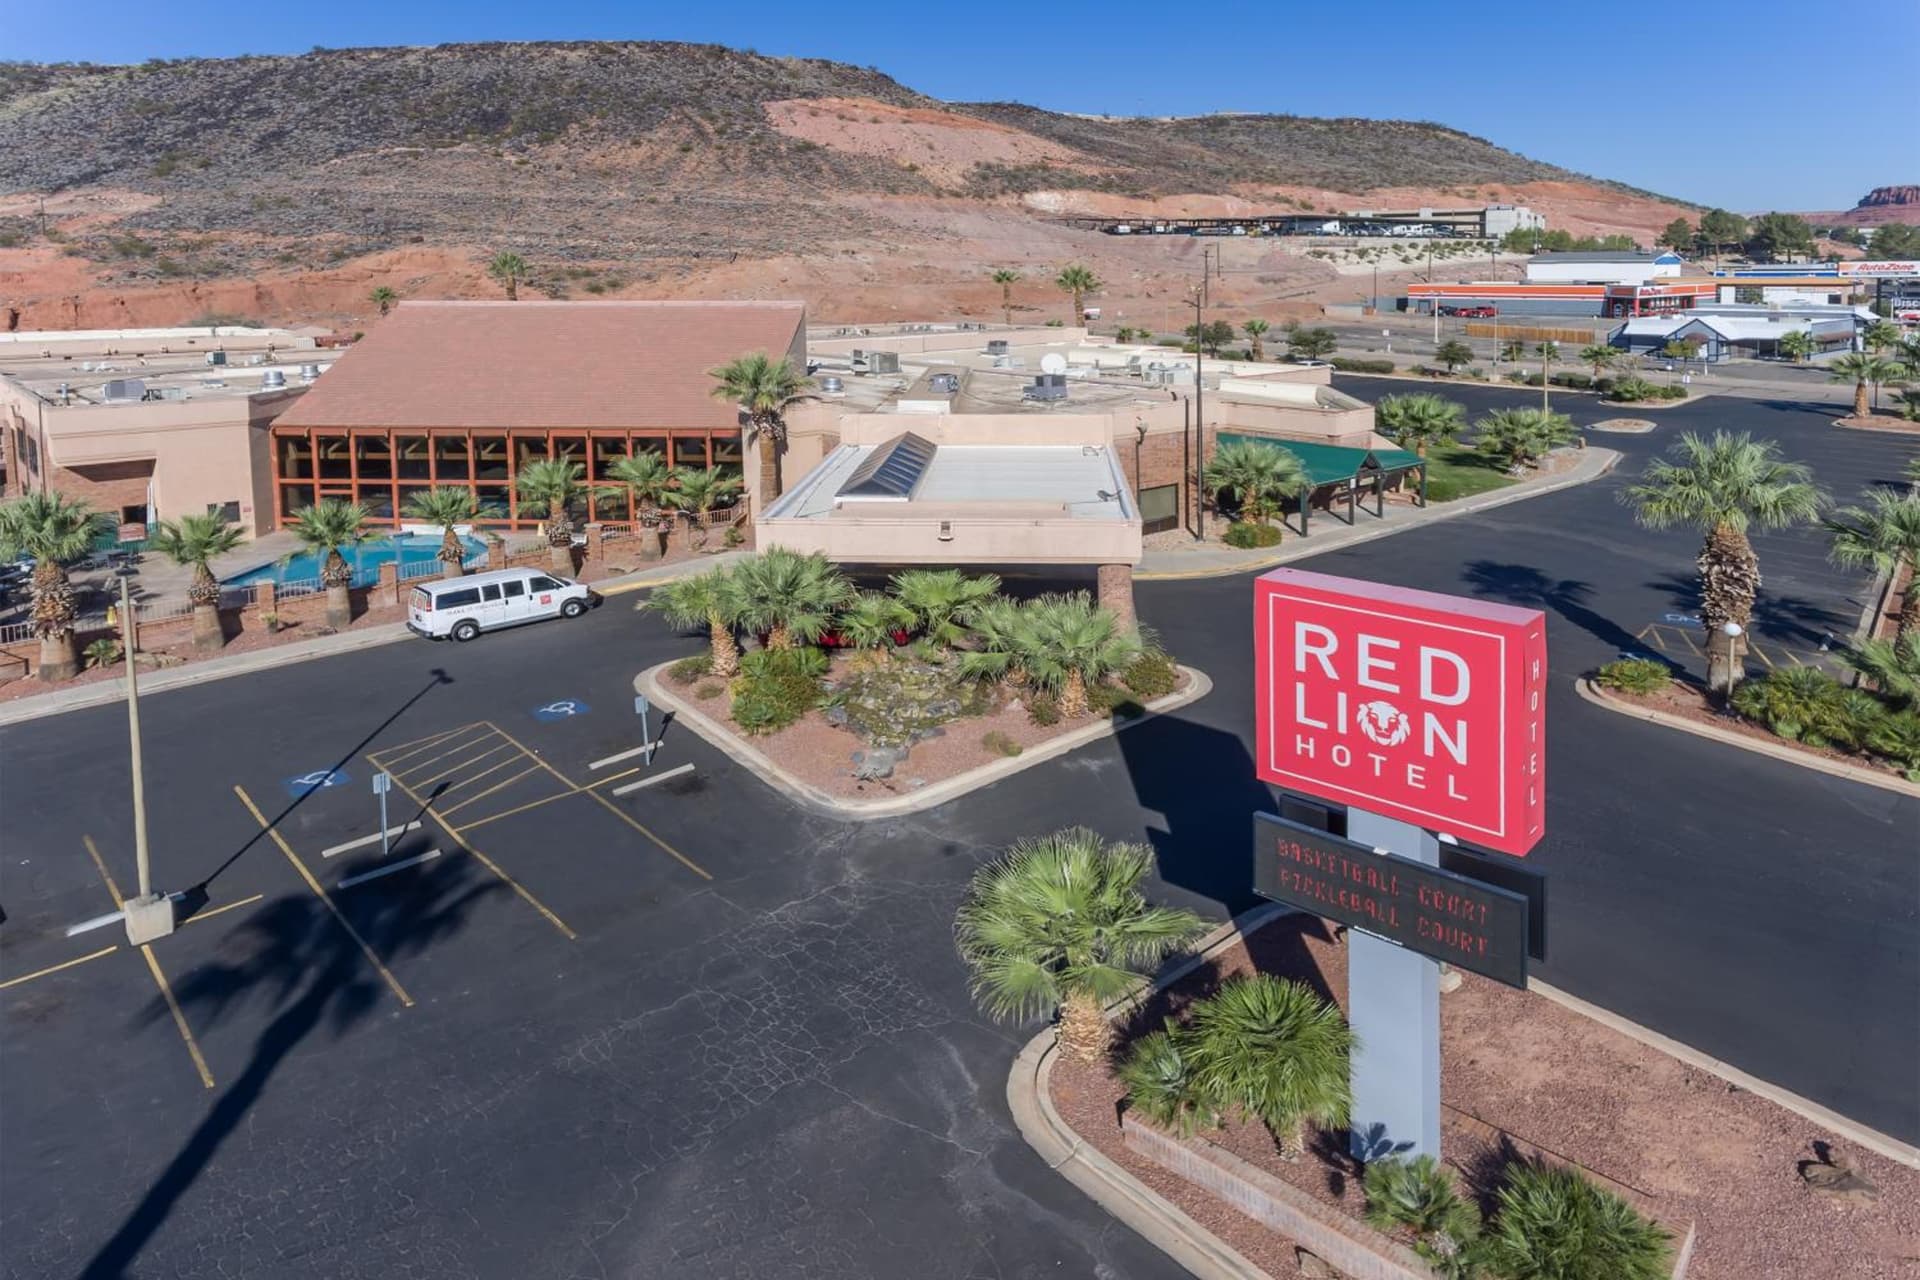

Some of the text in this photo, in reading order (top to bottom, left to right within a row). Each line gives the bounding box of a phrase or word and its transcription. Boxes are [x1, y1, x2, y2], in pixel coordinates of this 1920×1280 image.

[1857, 263, 1915, 271] AutoZone
[1295, 621, 1471, 706] RED
[1297, 734, 1468, 801] HOTEL
[1529, 659, 1540, 806] HOTEL
[1277, 837, 1488, 926] BASKETBALL COURT
[1280, 868, 1399, 928] PICKLEBALL
[1417, 917, 1488, 956] COURT
